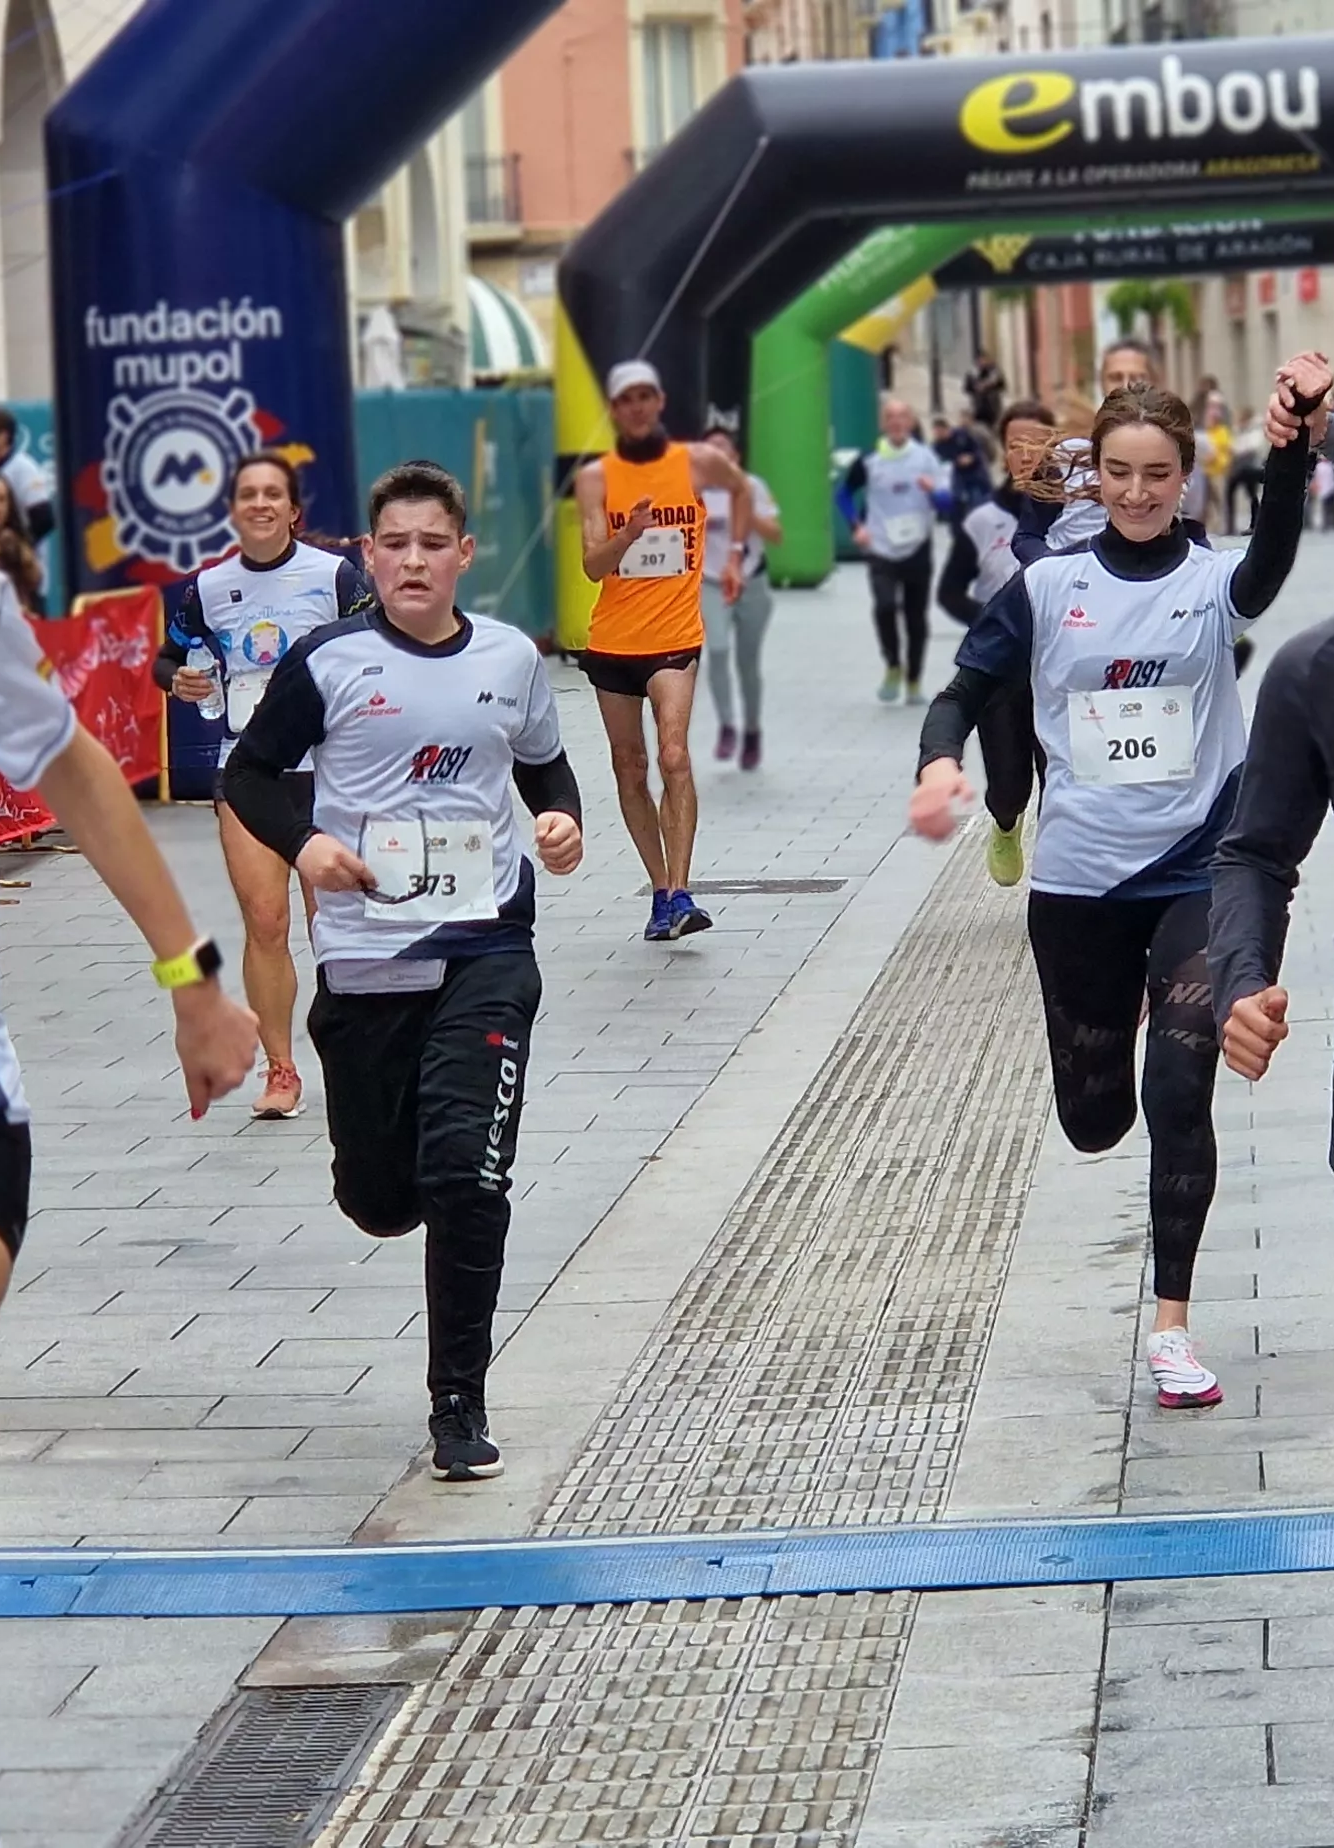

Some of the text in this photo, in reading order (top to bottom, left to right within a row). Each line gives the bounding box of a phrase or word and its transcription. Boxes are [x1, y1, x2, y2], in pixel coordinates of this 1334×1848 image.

[960, 55, 1320, 153] embou
[85, 298, 283, 347] fundación
[114, 342, 243, 391] mupol
[640, 553, 666, 567] 207
[1106, 736, 1157, 761] 206
[408, 873, 457, 897] 373
